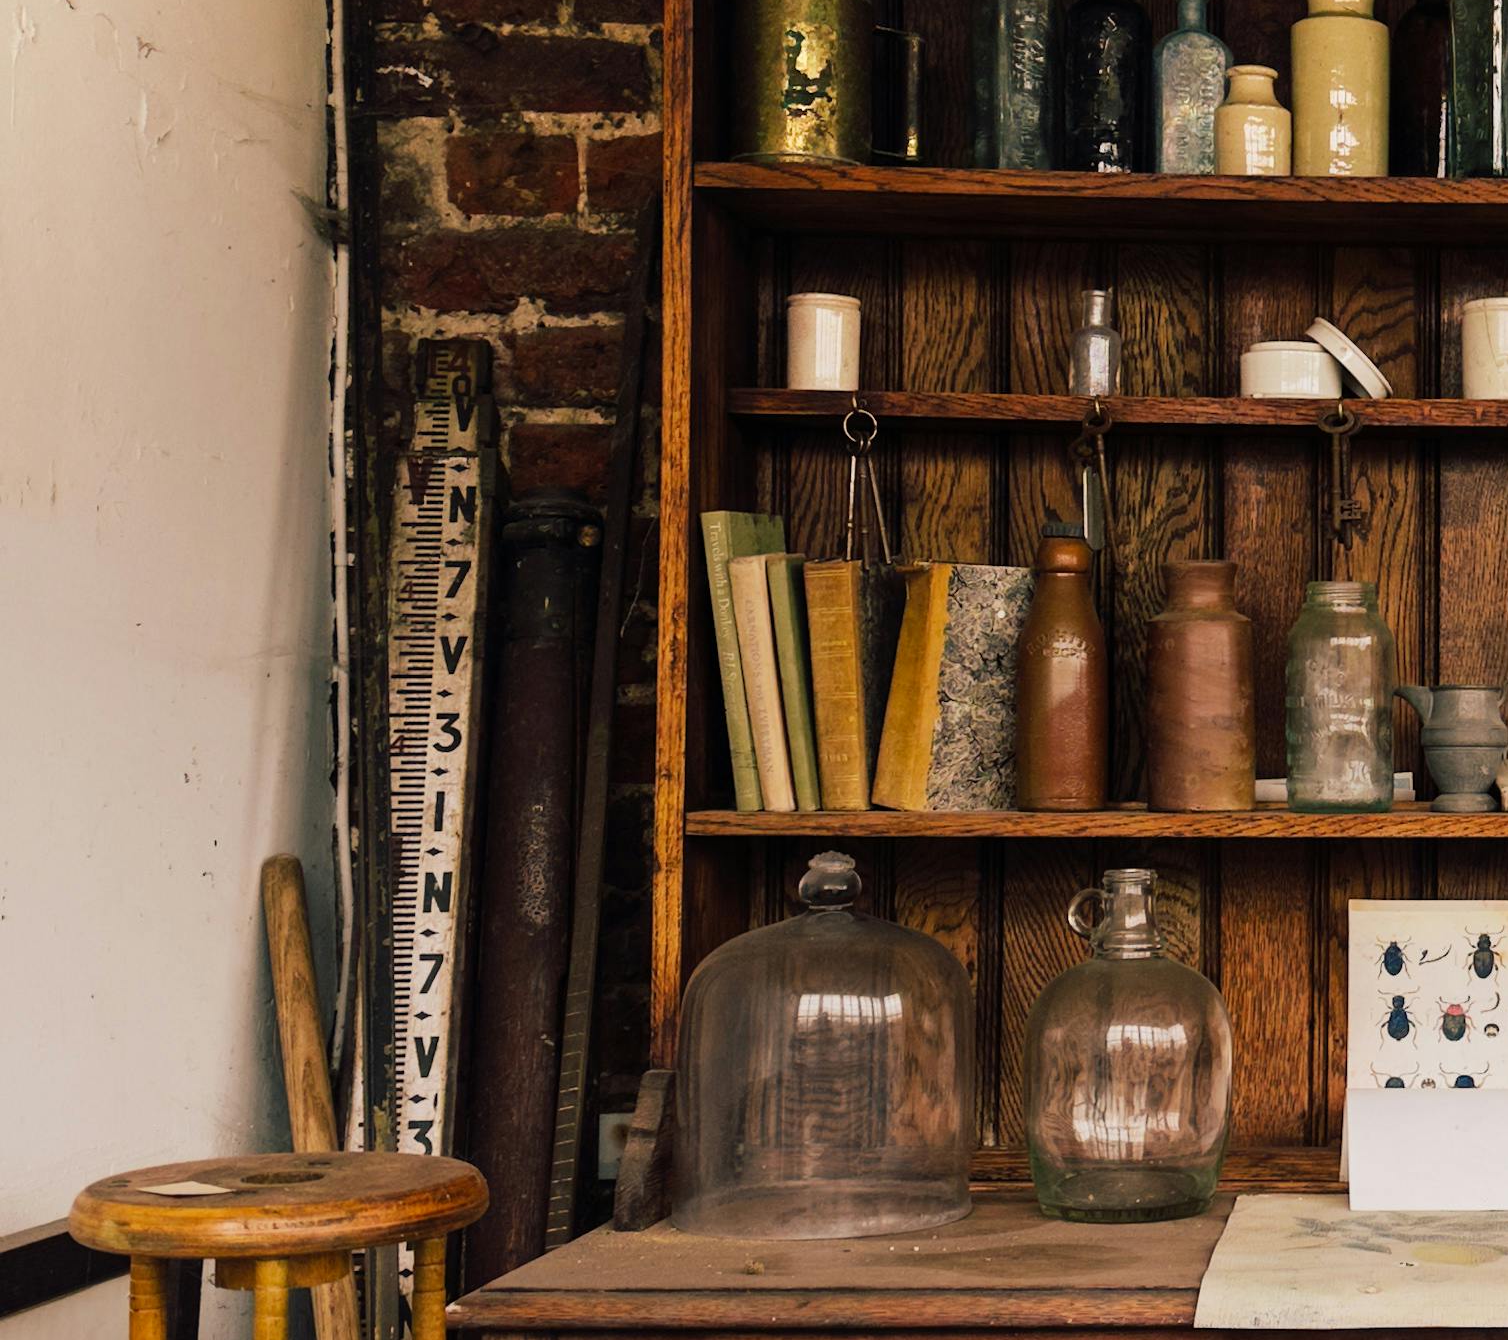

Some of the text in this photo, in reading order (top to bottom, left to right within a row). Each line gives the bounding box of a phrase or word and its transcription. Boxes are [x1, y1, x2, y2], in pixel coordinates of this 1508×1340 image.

[449, 486, 477, 524] N
[709, 521, 725, 562] Travels
[444, 560, 472, 599] 7
[713, 562, 727, 587] with
[439, 636, 469, 675] V
[745, 599, 763, 679] CARNATIONS
[758, 707, 774, 773] EVERYMAN
[432, 713, 462, 753] 3
[422, 871, 453, 913] N
[419, 954, 445, 994] 7
[413, 1036, 440, 1078] V
[407, 1120, 434, 1155] 3
